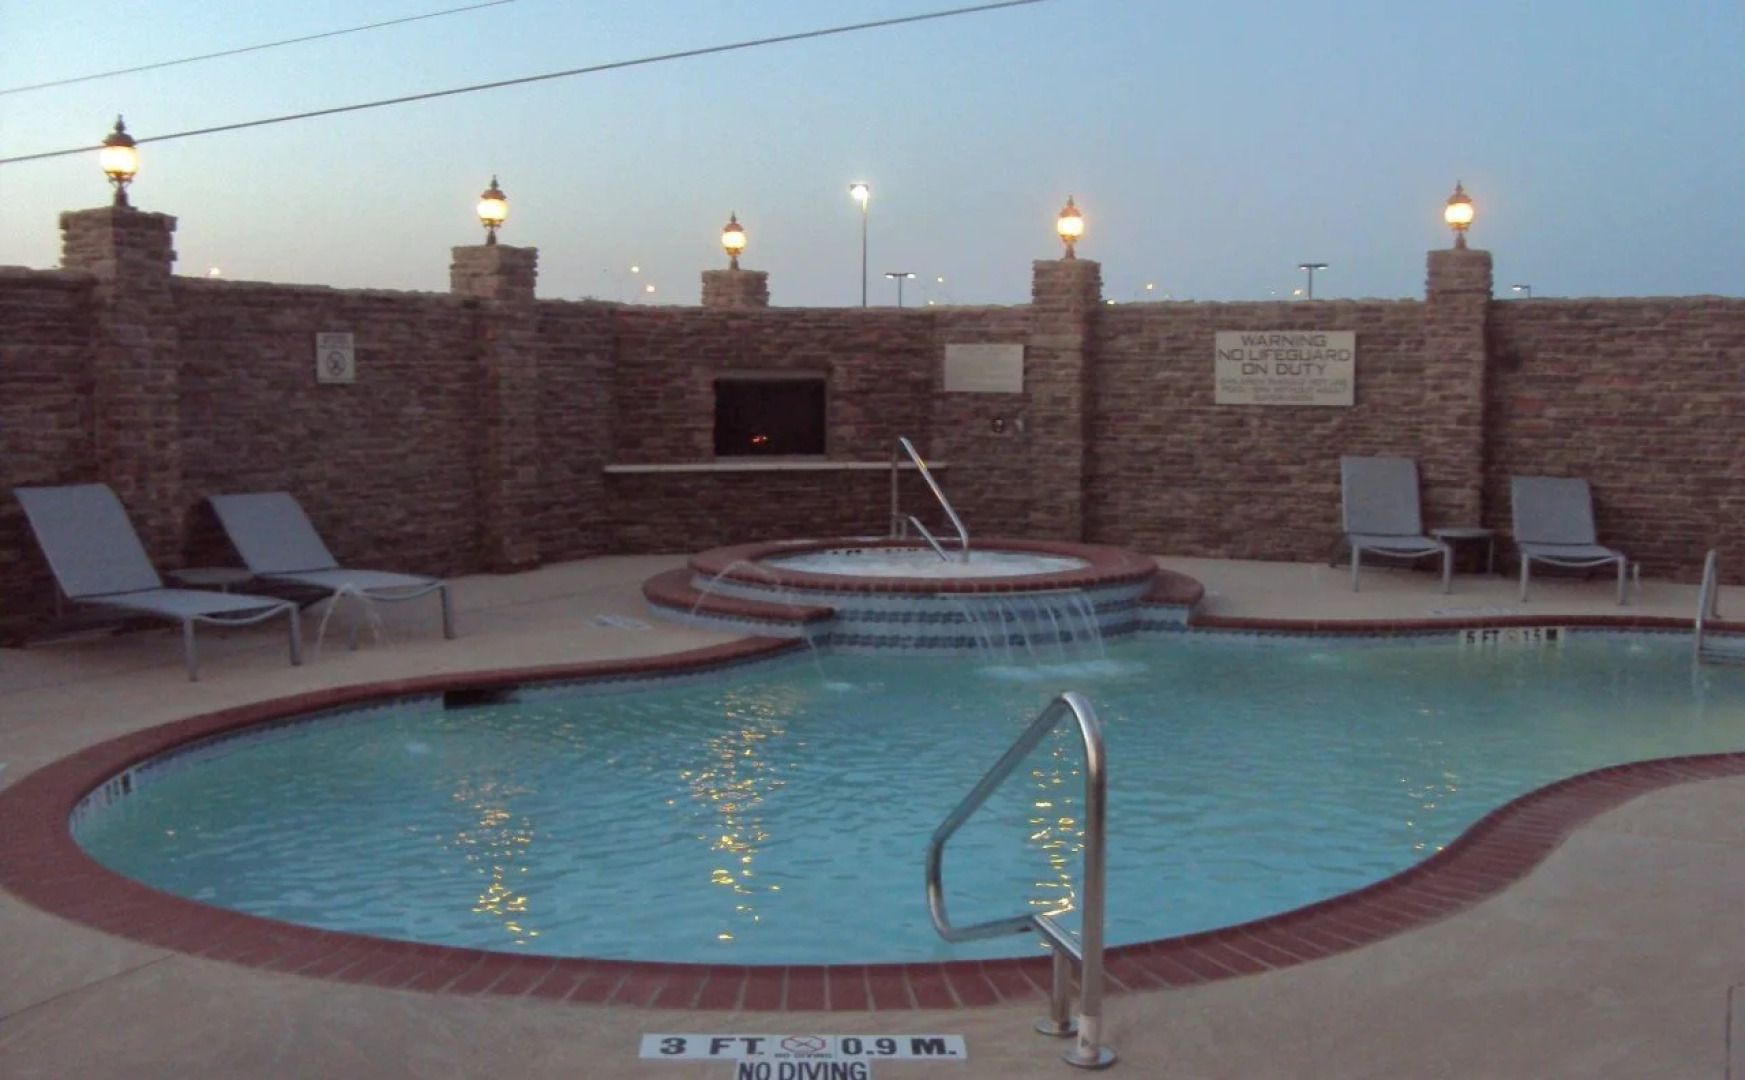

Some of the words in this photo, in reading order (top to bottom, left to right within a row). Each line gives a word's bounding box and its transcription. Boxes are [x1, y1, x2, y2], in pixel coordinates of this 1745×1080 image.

[1241, 334, 1328, 346] WARNING
[1217, 349, 1244, 361] NO
[1249, 349, 1352, 361] LIFEGUARD
[1241, 363, 1268, 375] ON
[1275, 363, 1327, 375] DUTY
[660, 1037, 688, 1055] 3
[841, 1037, 898, 1055] 0.9
[911, 1037, 957, 1055] M.
[737, 1061, 771, 1080] NO
[778, 1061, 868, 1080] DIVING
